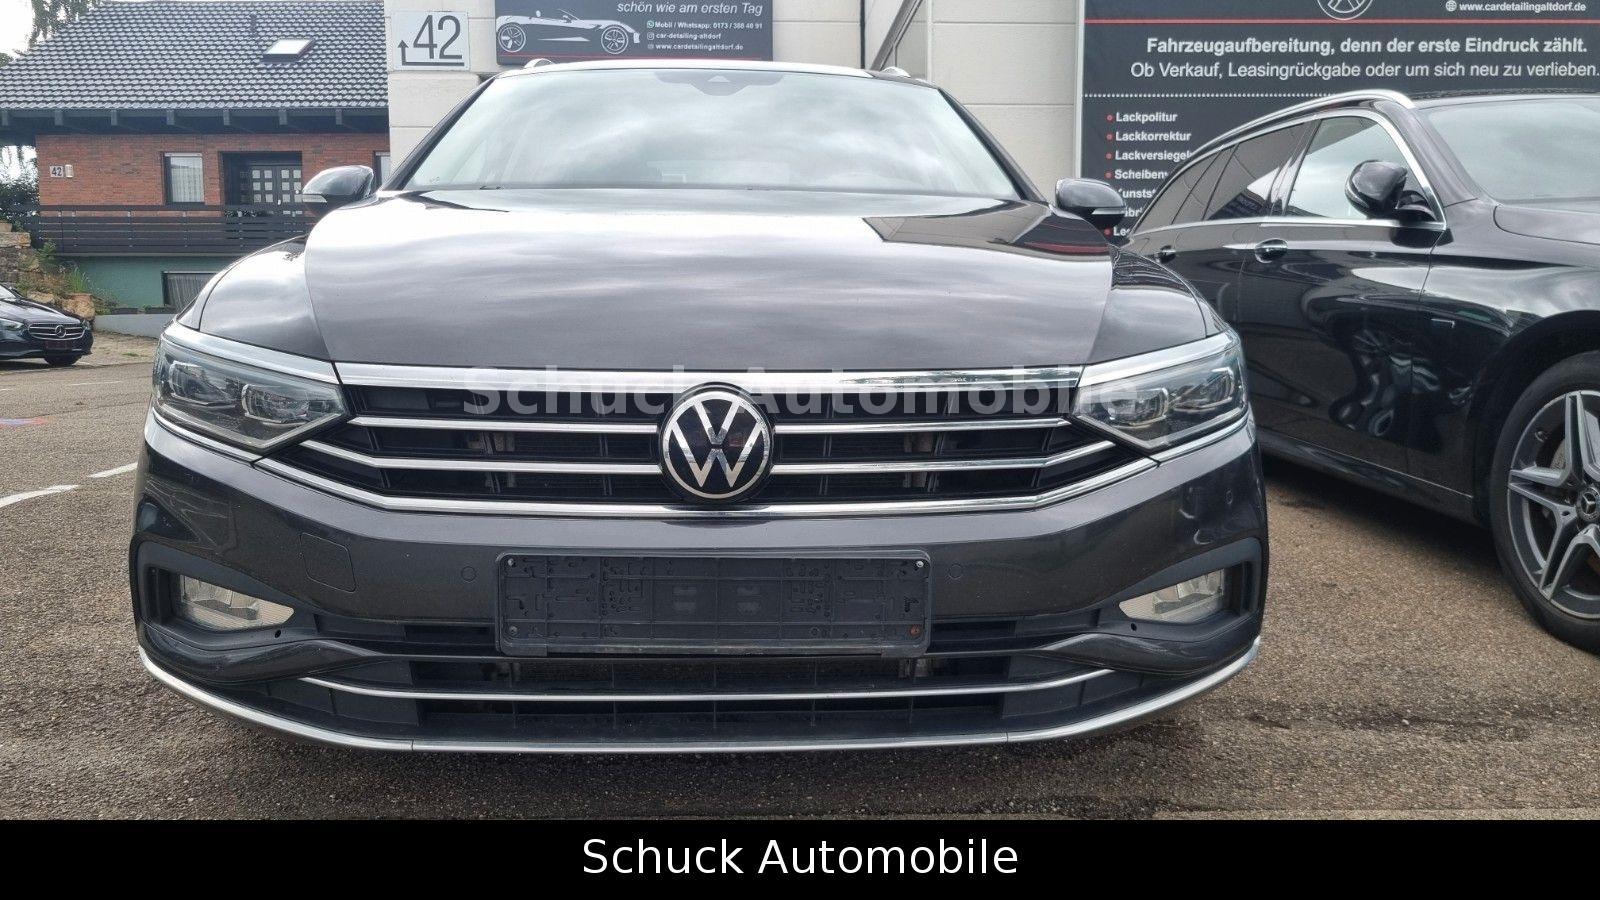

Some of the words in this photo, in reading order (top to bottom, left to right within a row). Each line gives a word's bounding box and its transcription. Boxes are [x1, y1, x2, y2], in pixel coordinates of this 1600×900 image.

[616, 2, 652, 13] schön
[656, 2, 676, 13] wie
[679, 4, 698, 13] am
[742, 3, 763, 16] Tag
[1459, 1, 1586, 13] www.cardetailingaltdorf.de
[655, 21, 673, 29] Mobil
[412, 14, 463, 60] 42
[1146, 37, 1335, 56] Fahrzeugaufbereitung,
[1340, 37, 1382, 53] denn
[1386, 37, 1415, 53] der
[1418, 38, 1460, 53] erste
[1465, 37, 1540, 53] Eindruck
[1543, 37, 1588, 53] zählt.
[1130, 62, 1155, 78] Ob
[1159, 61, 1223, 79] Verkauf,
[1228, 61, 1361, 81] Leasingrückgabe
[1365, 61, 1402, 77] oder
[1405, 64, 1430, 77] um
[1433, 61, 1466, 77] sich
[1470, 64, 1499, 77] neu
[1502, 64, 1522, 77] zu
[1526, 61, 1600, 77] verlieben.
[1116, 112, 1178, 124] Lackpolitur
[1115, 131, 1192, 141] Lackkorrektur
[1115, 150, 1191, 162] Lackversiegel
[51, 166, 63, 177] 42
[1118, 188, 1156, 199] unsts
